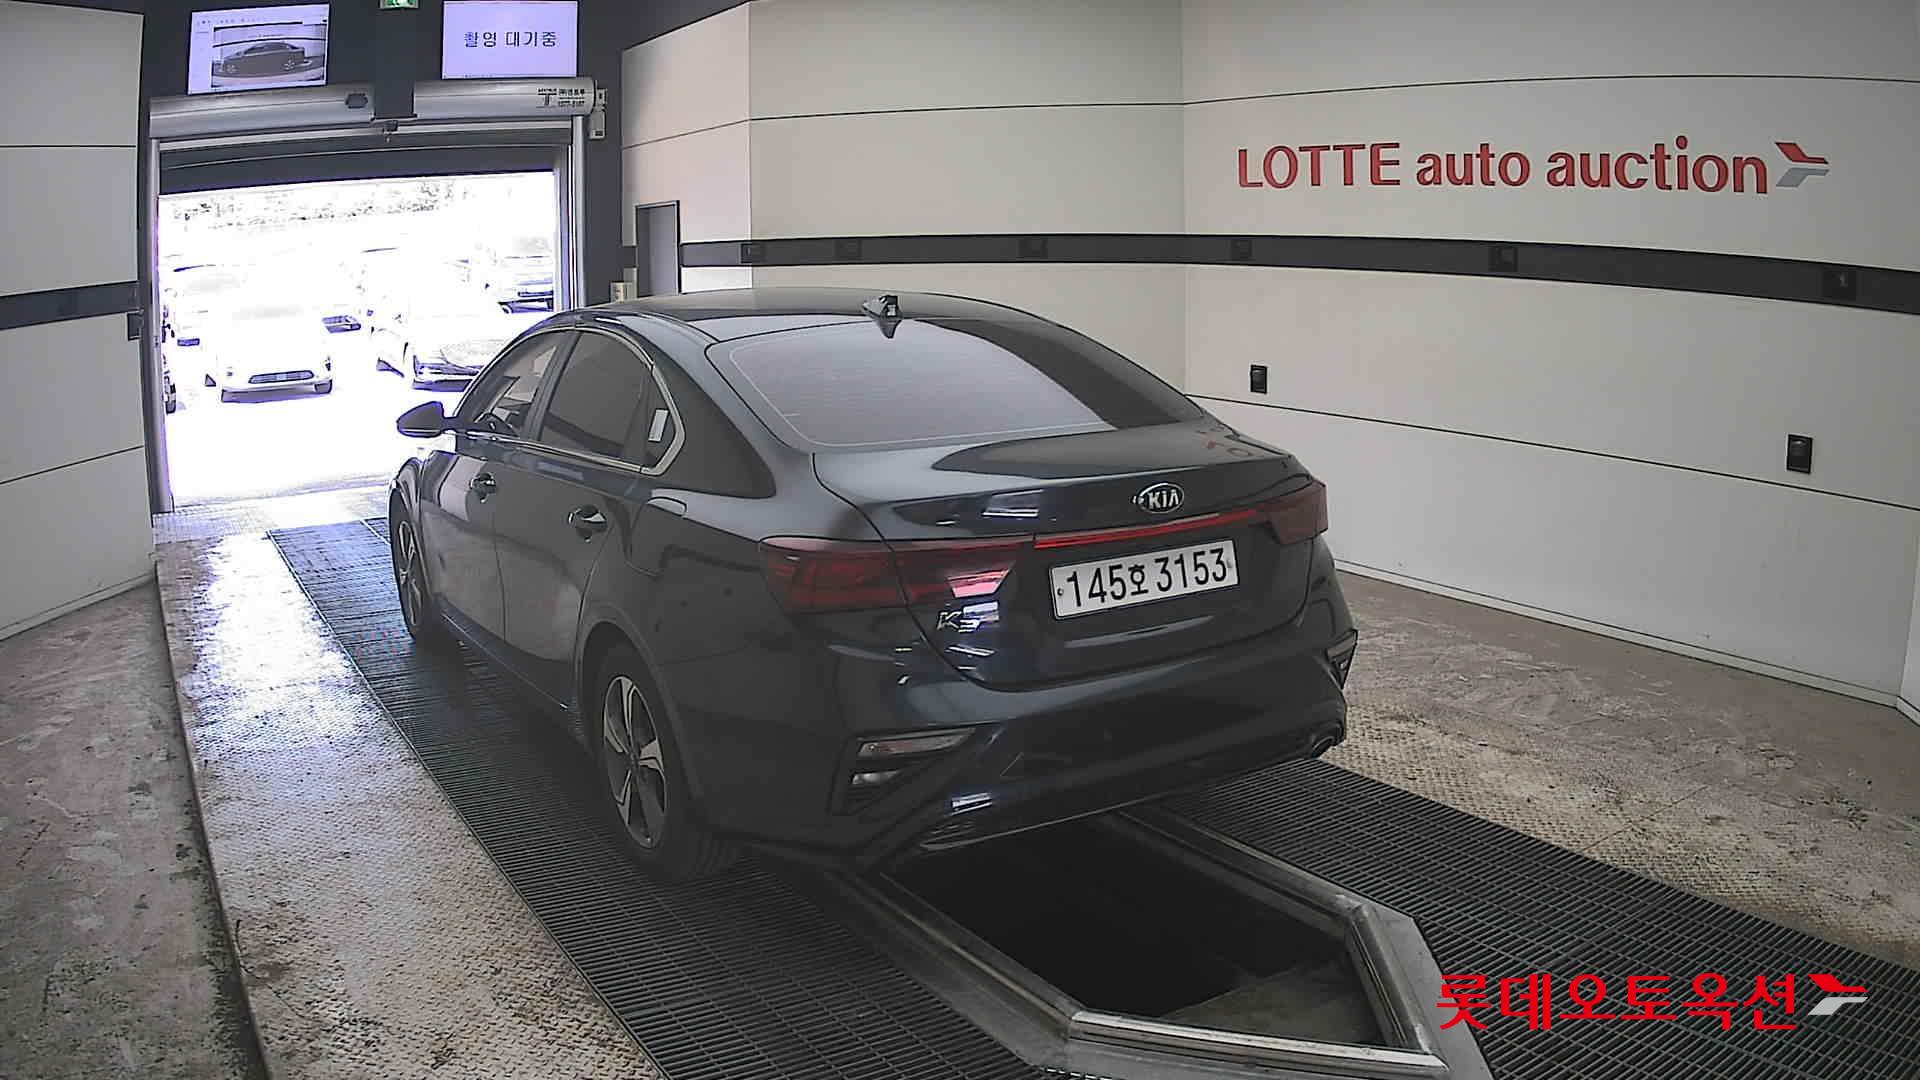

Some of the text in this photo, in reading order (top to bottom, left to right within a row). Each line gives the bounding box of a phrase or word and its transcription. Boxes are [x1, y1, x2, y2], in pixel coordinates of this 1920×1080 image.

[464, 31, 557, 48] 촬영 대기중
[1238, 135, 1769, 194] LOTTE auto auction
[1147, 488, 1180, 509] KIA
[1066, 547, 1228, 608] 145호 3153
